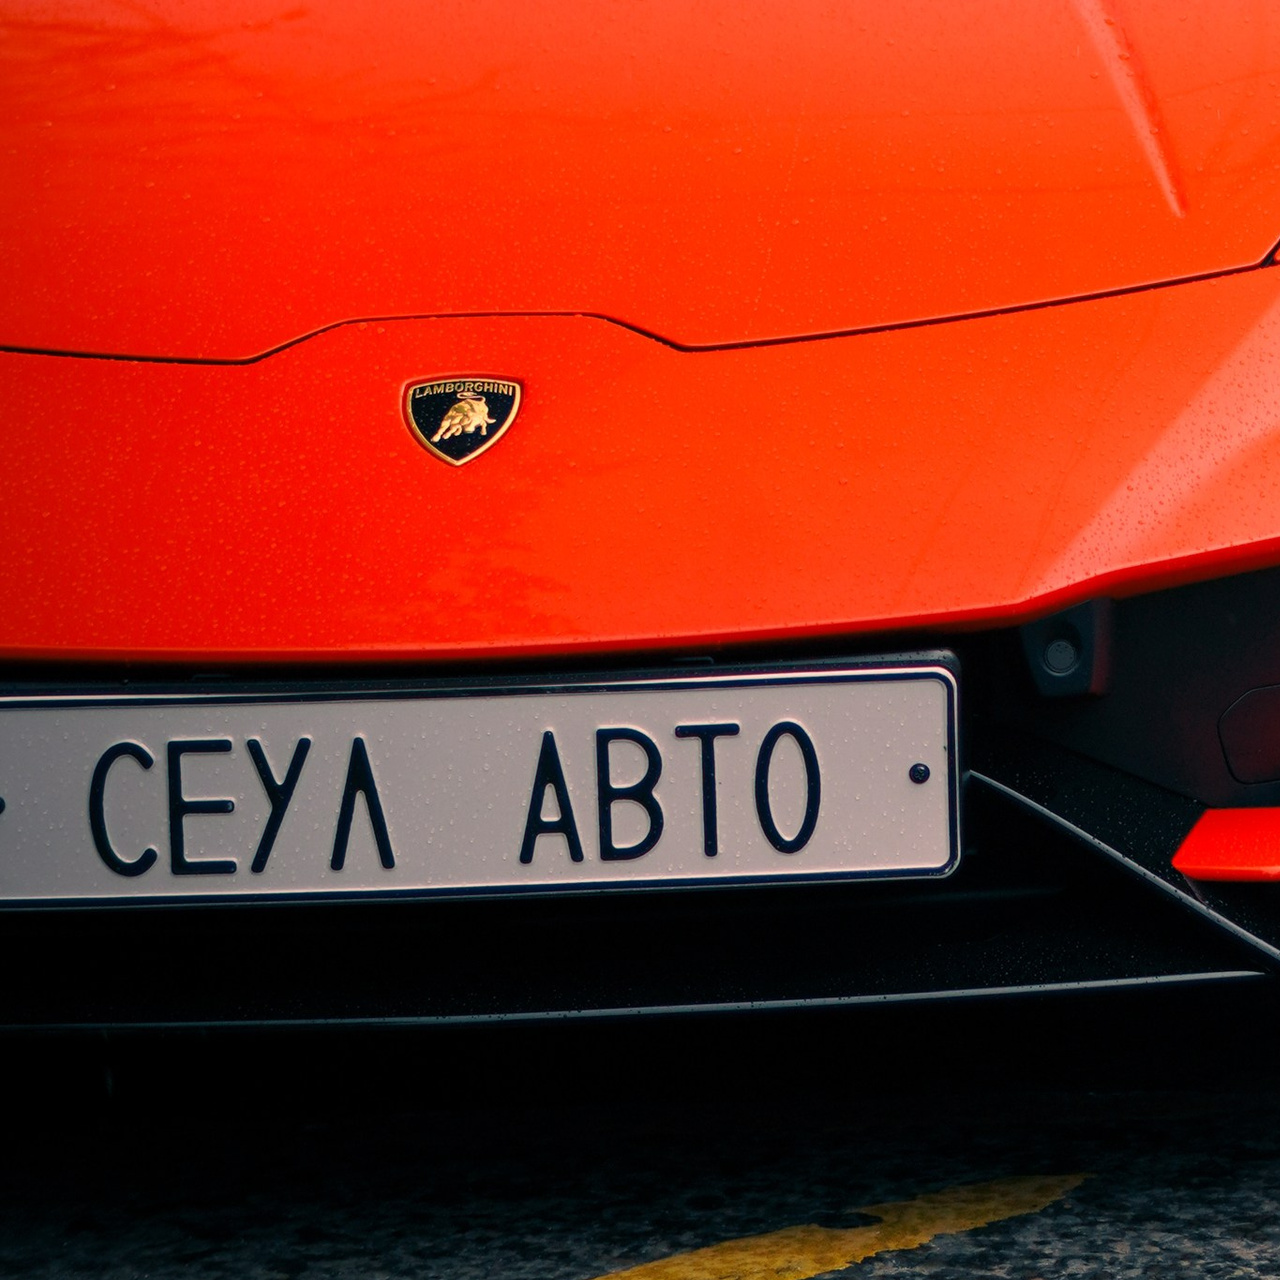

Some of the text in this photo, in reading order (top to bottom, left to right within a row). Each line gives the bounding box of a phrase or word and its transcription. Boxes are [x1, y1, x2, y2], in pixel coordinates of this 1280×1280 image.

[415, 382, 513, 398] LAMBORGHINI
[88, 721, 822, 877] СЕУЛ АВТО
